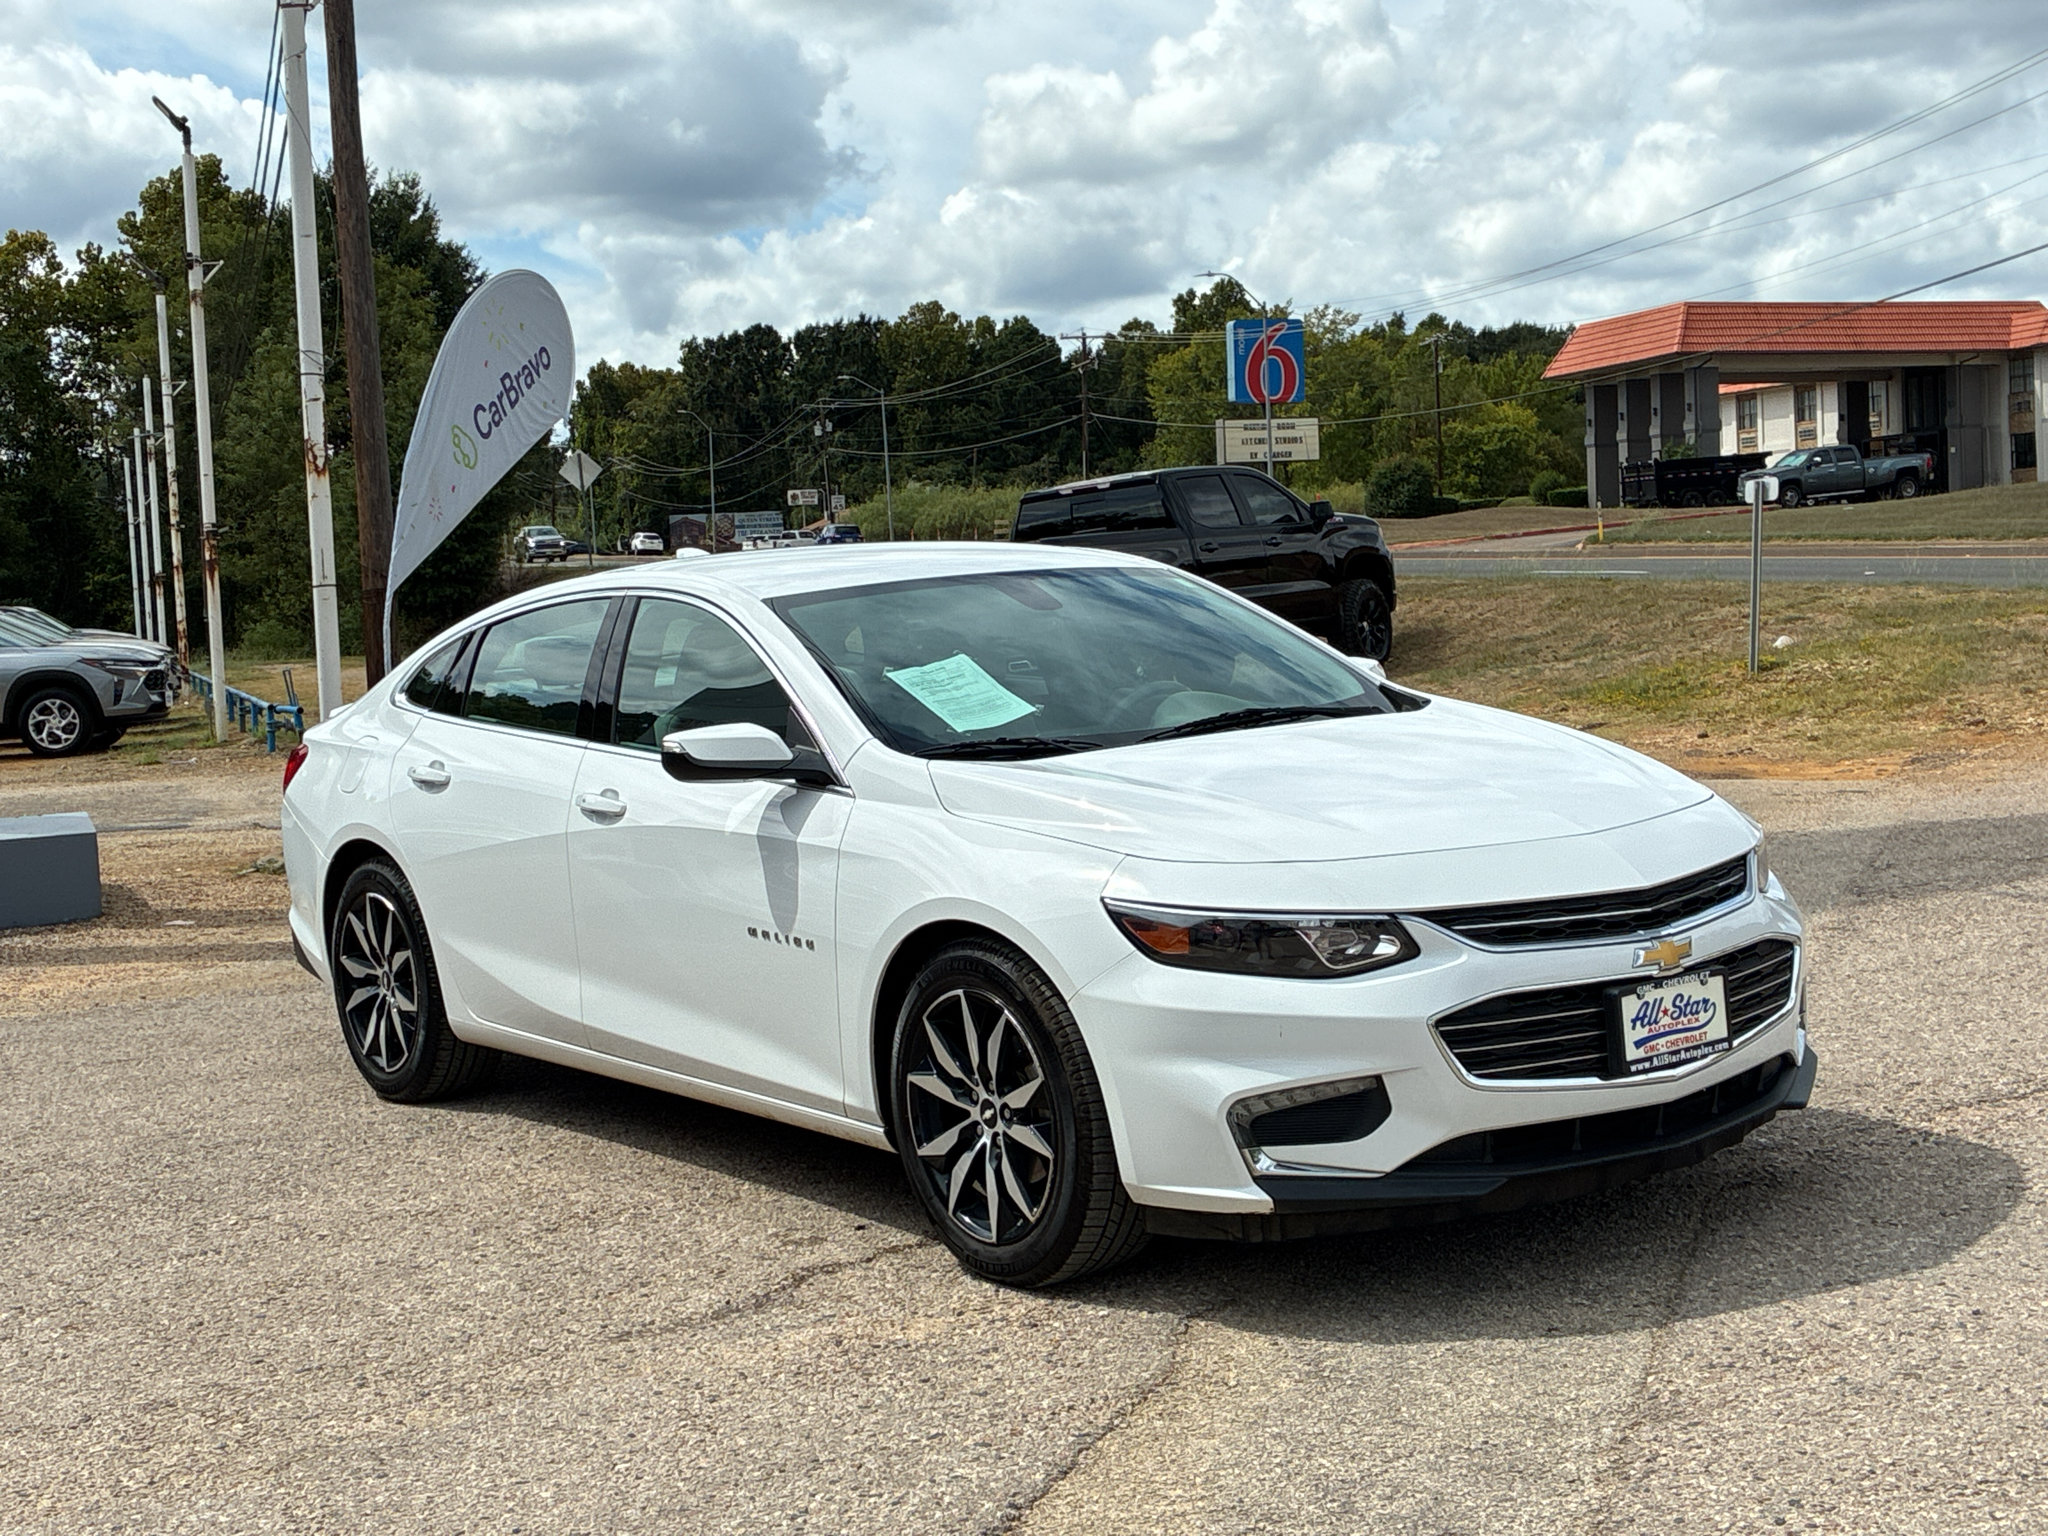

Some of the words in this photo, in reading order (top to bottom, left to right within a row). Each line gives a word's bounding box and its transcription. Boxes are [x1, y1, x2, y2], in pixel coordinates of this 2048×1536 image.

[1245, 322, 1299, 403] 6
[473, 346, 551, 440] CarBravo
[1264, 451, 1292, 459] CARGER
[747, 926, 815, 951] MALIBU
[1637, 983, 1656, 994] GMC
[1662, 971, 1710, 989] CHEVROLET
[1631, 996, 1664, 1030] All
[1670, 993, 1711, 1020] Star
[1647, 1016, 1701, 1034] AUTOPLEX
[1643, 1042, 1661, 1055] GMC
[1665, 1031, 1708, 1050] CHEVROLET
[1630, 1041, 1730, 1072] www.AllStarAutoplex.com
